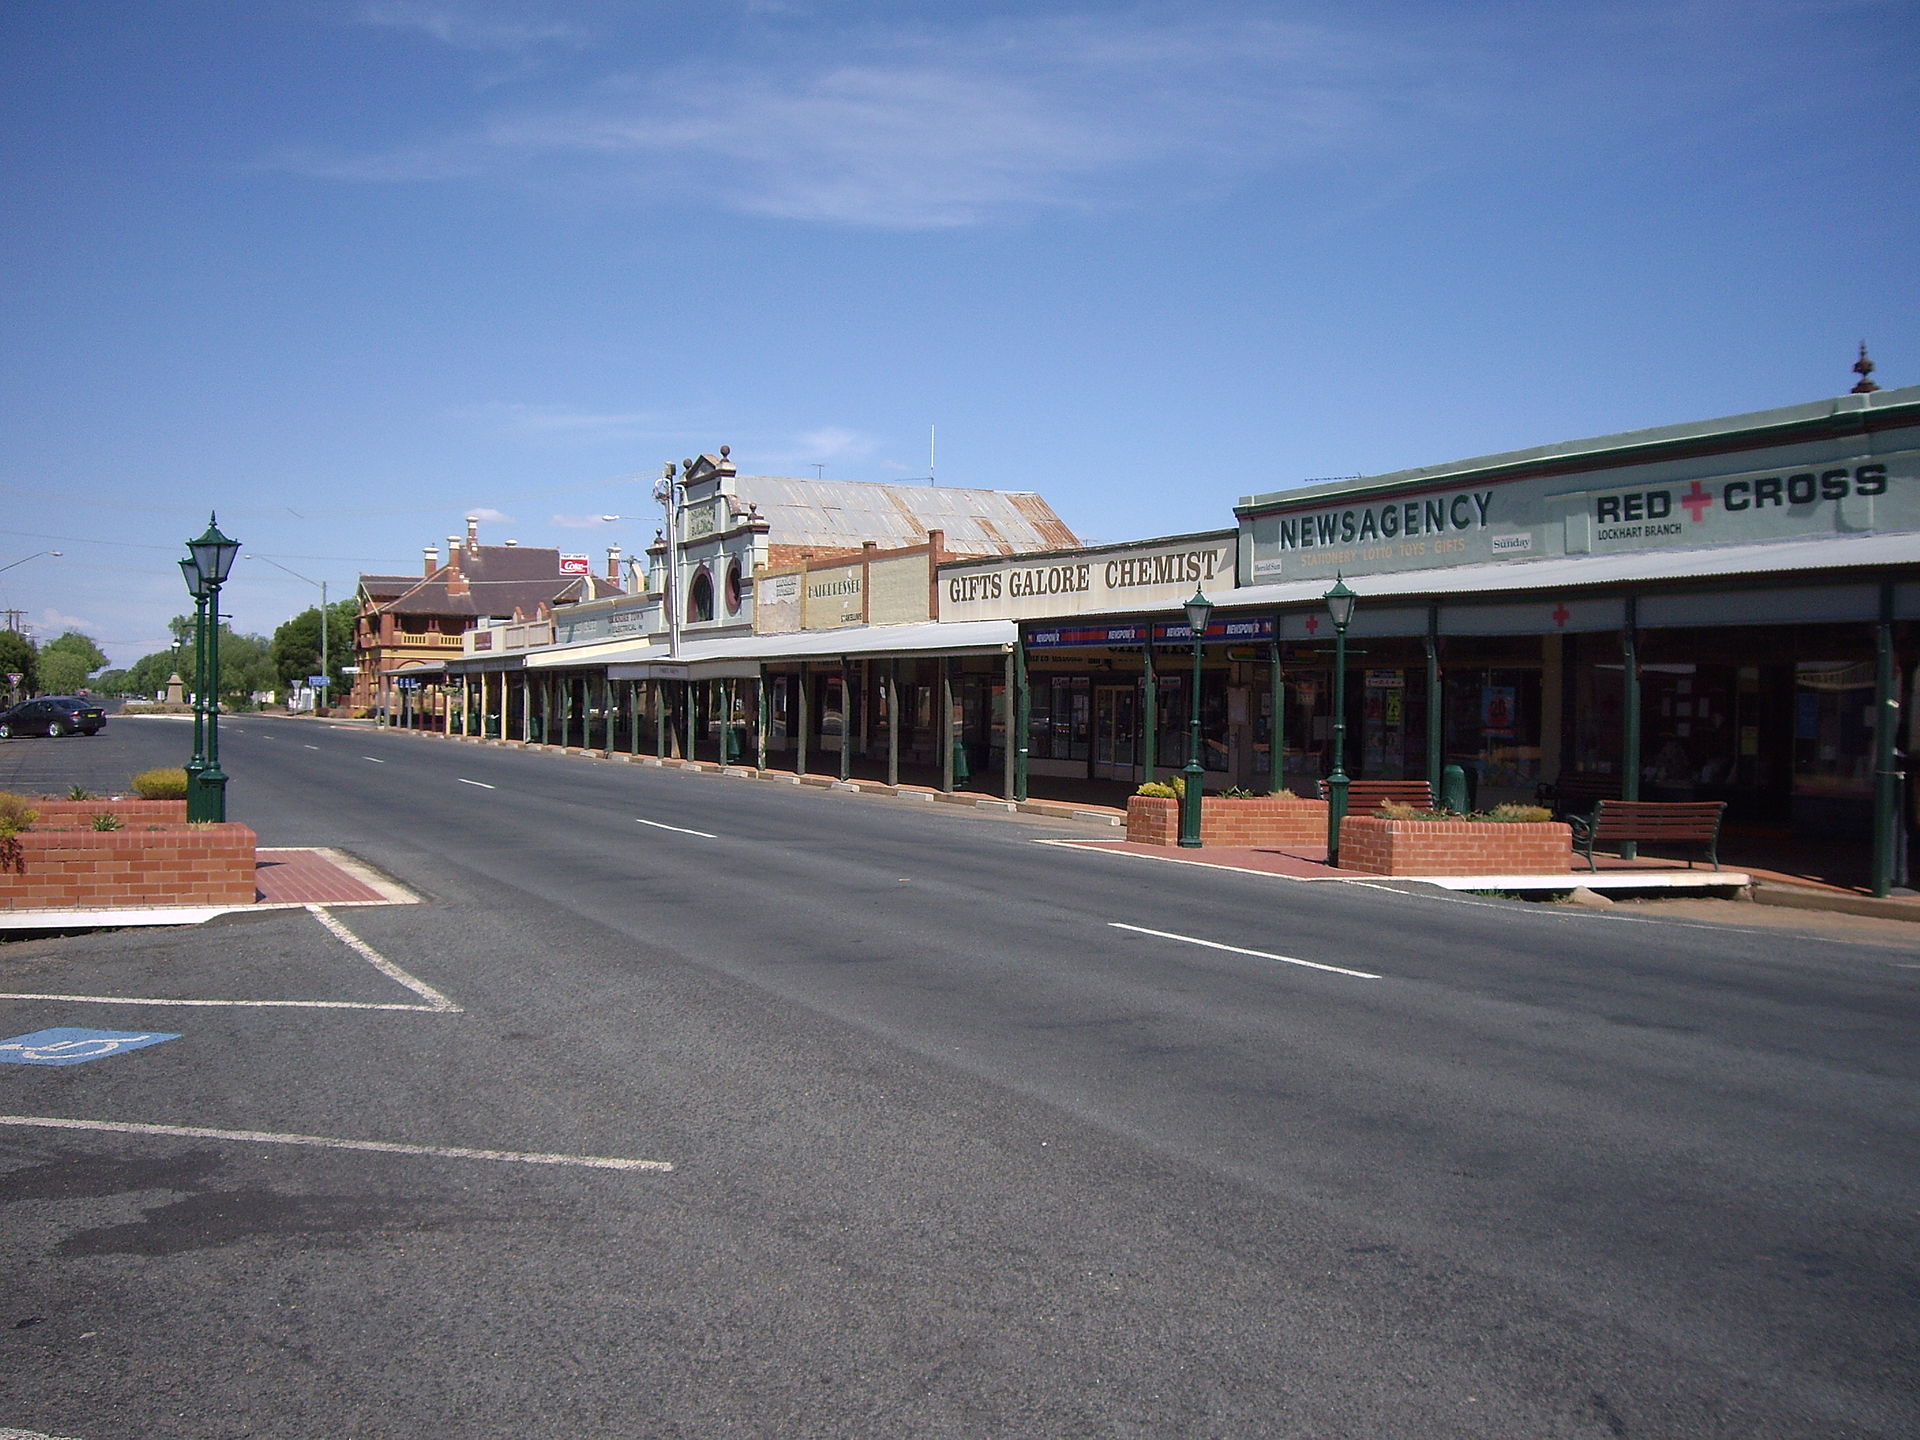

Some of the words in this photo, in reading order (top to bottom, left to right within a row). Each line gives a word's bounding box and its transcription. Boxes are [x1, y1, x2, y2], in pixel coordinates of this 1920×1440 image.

[1598, 490, 1672, 523] RED
[1724, 464, 1888, 511] CROSS
[1279, 491, 1493, 551] NEWSAGENCY
[1598, 526, 1642, 540] LOCKHART
[1645, 523, 1682, 537] BRANCH
[1301, 550, 1356, 567] STATIONERY
[1363, 546, 1393, 560] LOTTO
[1400, 542, 1425, 556] TOYS
[1435, 538, 1465, 553] GIFTS
[1494, 538, 1529, 549] Sunday
[950, 574, 1002, 602] GIFTS
[1009, 563, 1090, 598] GALORE
[1105, 550, 1218, 589] CHEMIST
